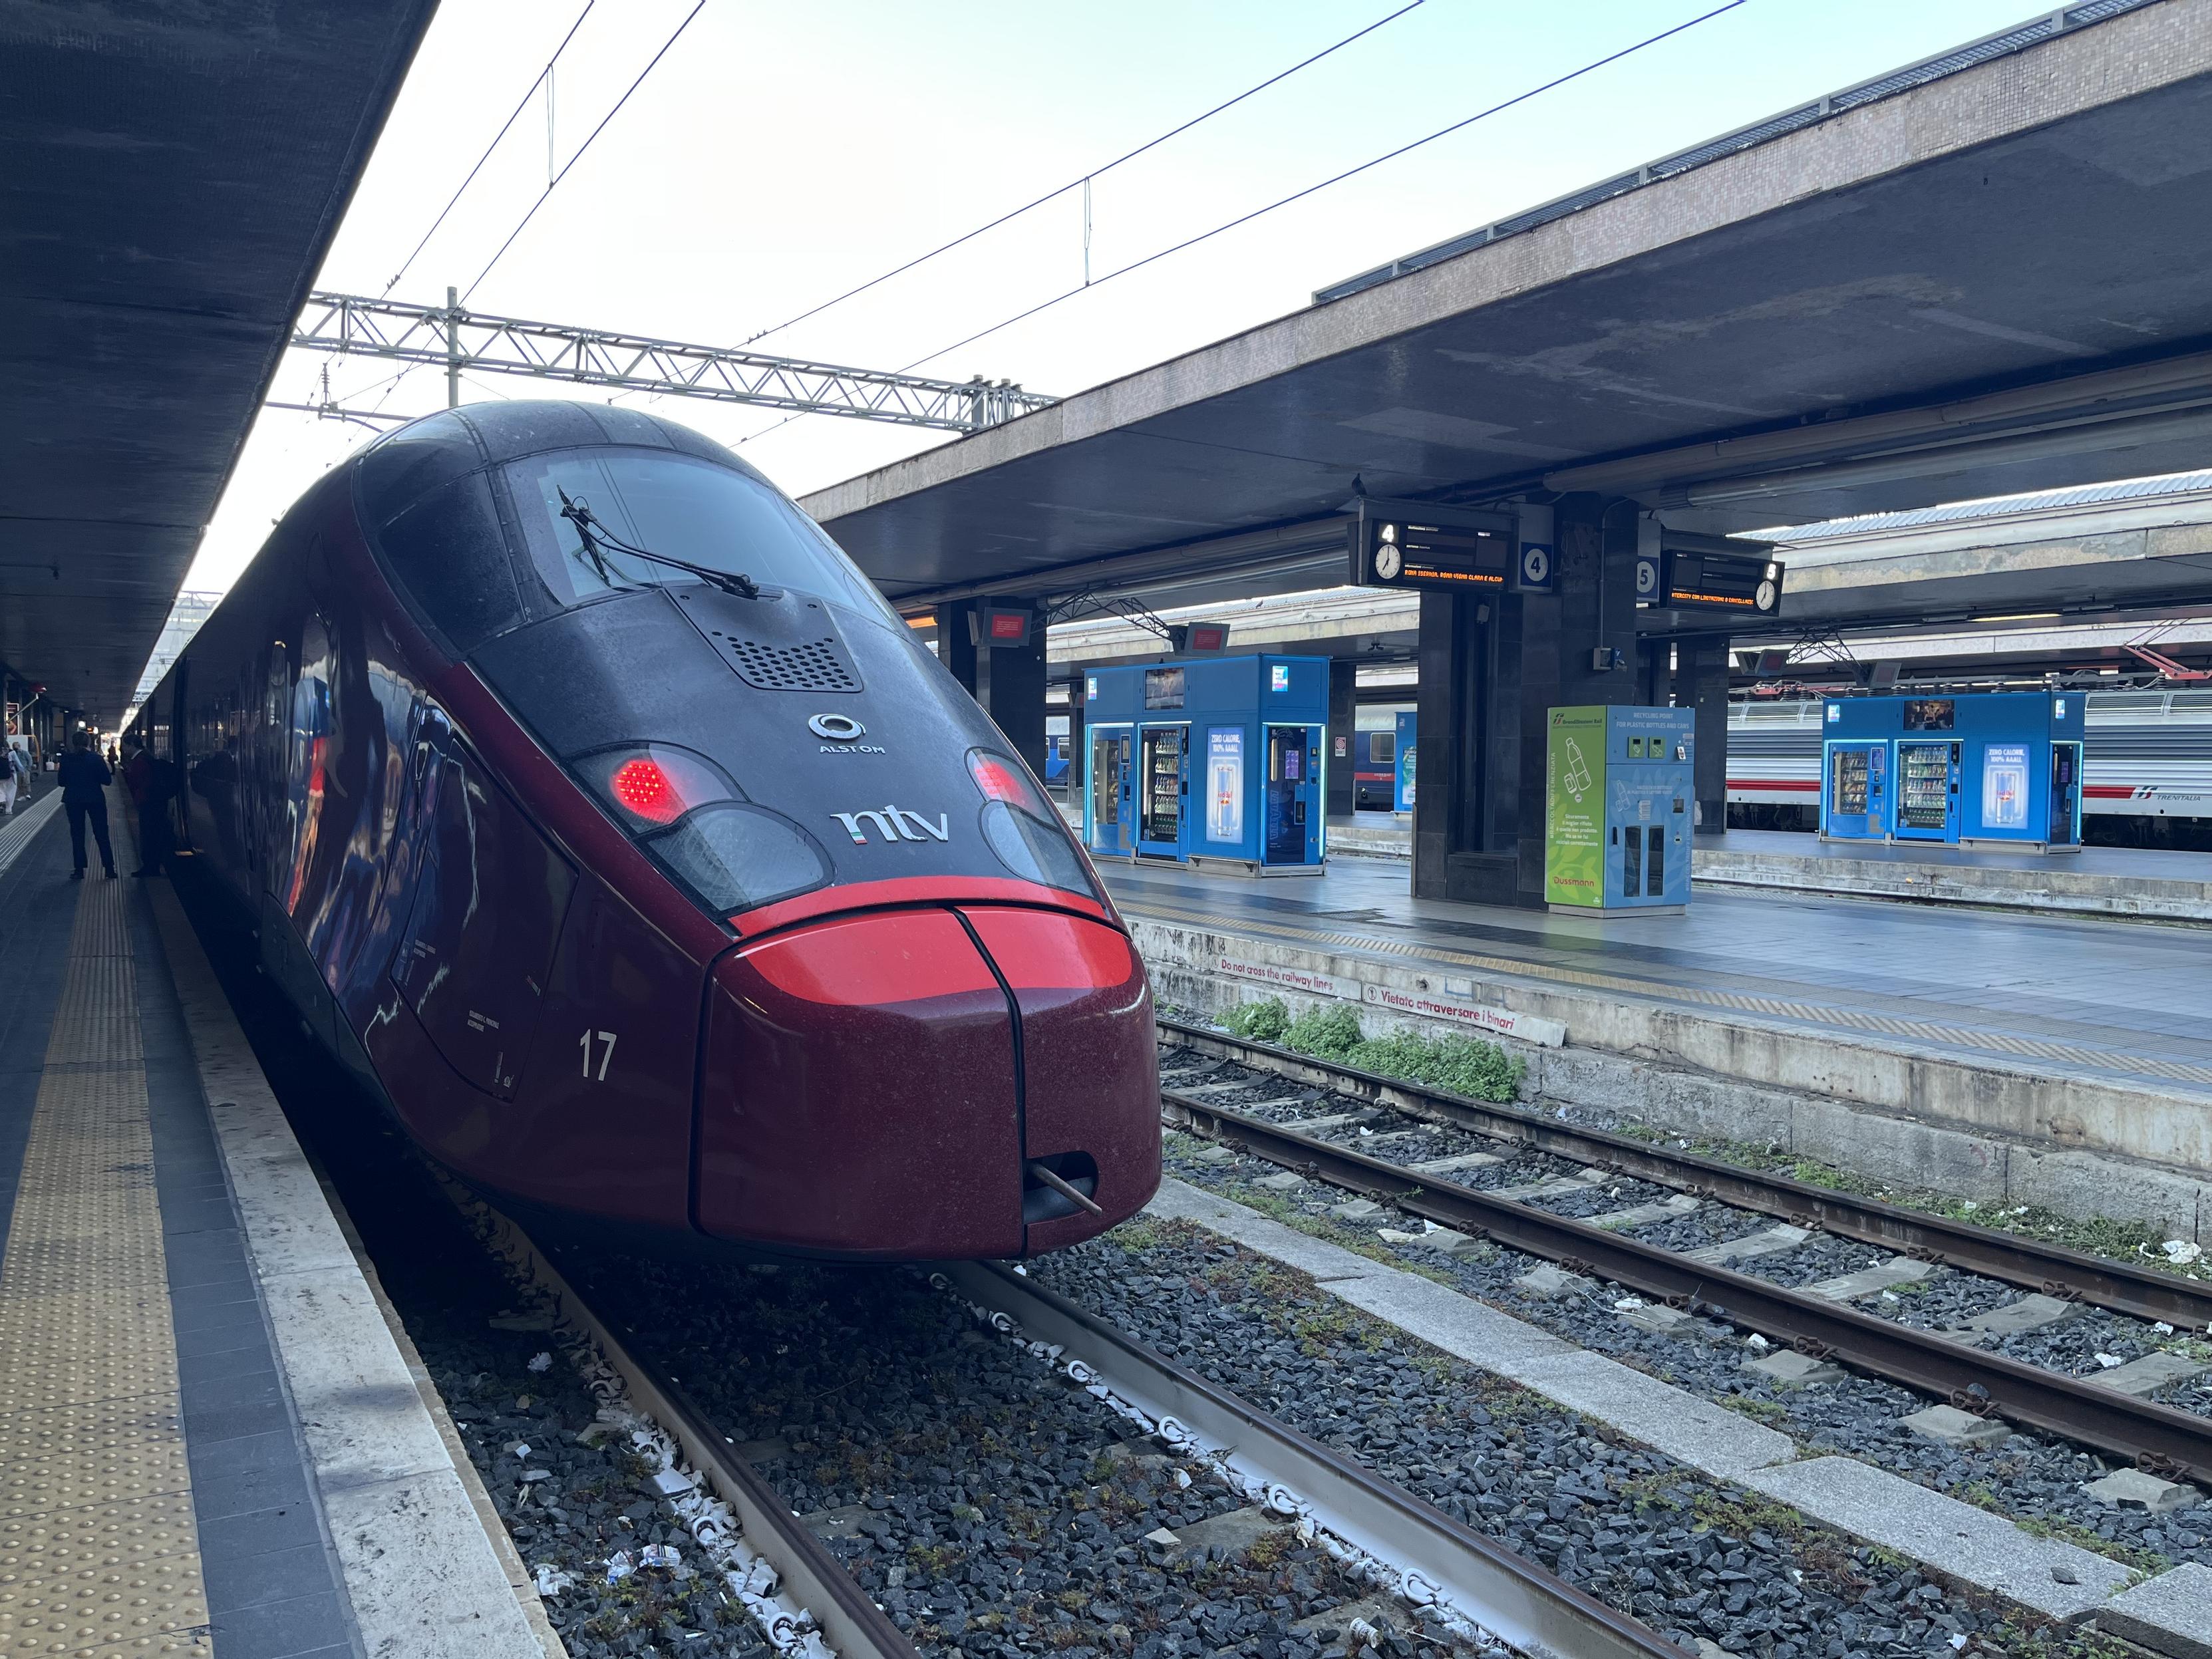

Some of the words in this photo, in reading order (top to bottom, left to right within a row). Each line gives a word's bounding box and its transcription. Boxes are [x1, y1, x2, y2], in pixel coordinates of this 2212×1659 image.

[1382, 524, 1394, 542] 4
[1531, 557, 1541, 573] 4
[1767, 563, 1776, 579] 5
[1640, 569, 1649, 585] 5
[1211, 734, 1222, 743] ZERO
[820, 745, 886, 754] ALSTOM
[830, 804, 949, 845] ntv
[1554, 876, 1595, 887] Dussmann
[1221, 959, 1231, 970] Do
[1233, 964, 1245, 973] not
[1247, 967, 1265, 977] cross
[1267, 967, 1279, 979] the
[1282, 971, 1312, 988] railway
[1314, 976, 1333, 990] lines
[1381, 990, 1414, 1008] Vietato
[1417, 999, 1480, 1020] attraversare
[1482, 1010, 1486, 1022] i
[1487, 1010, 1515, 1030] binari
[579, 1028, 617, 1081] 17
